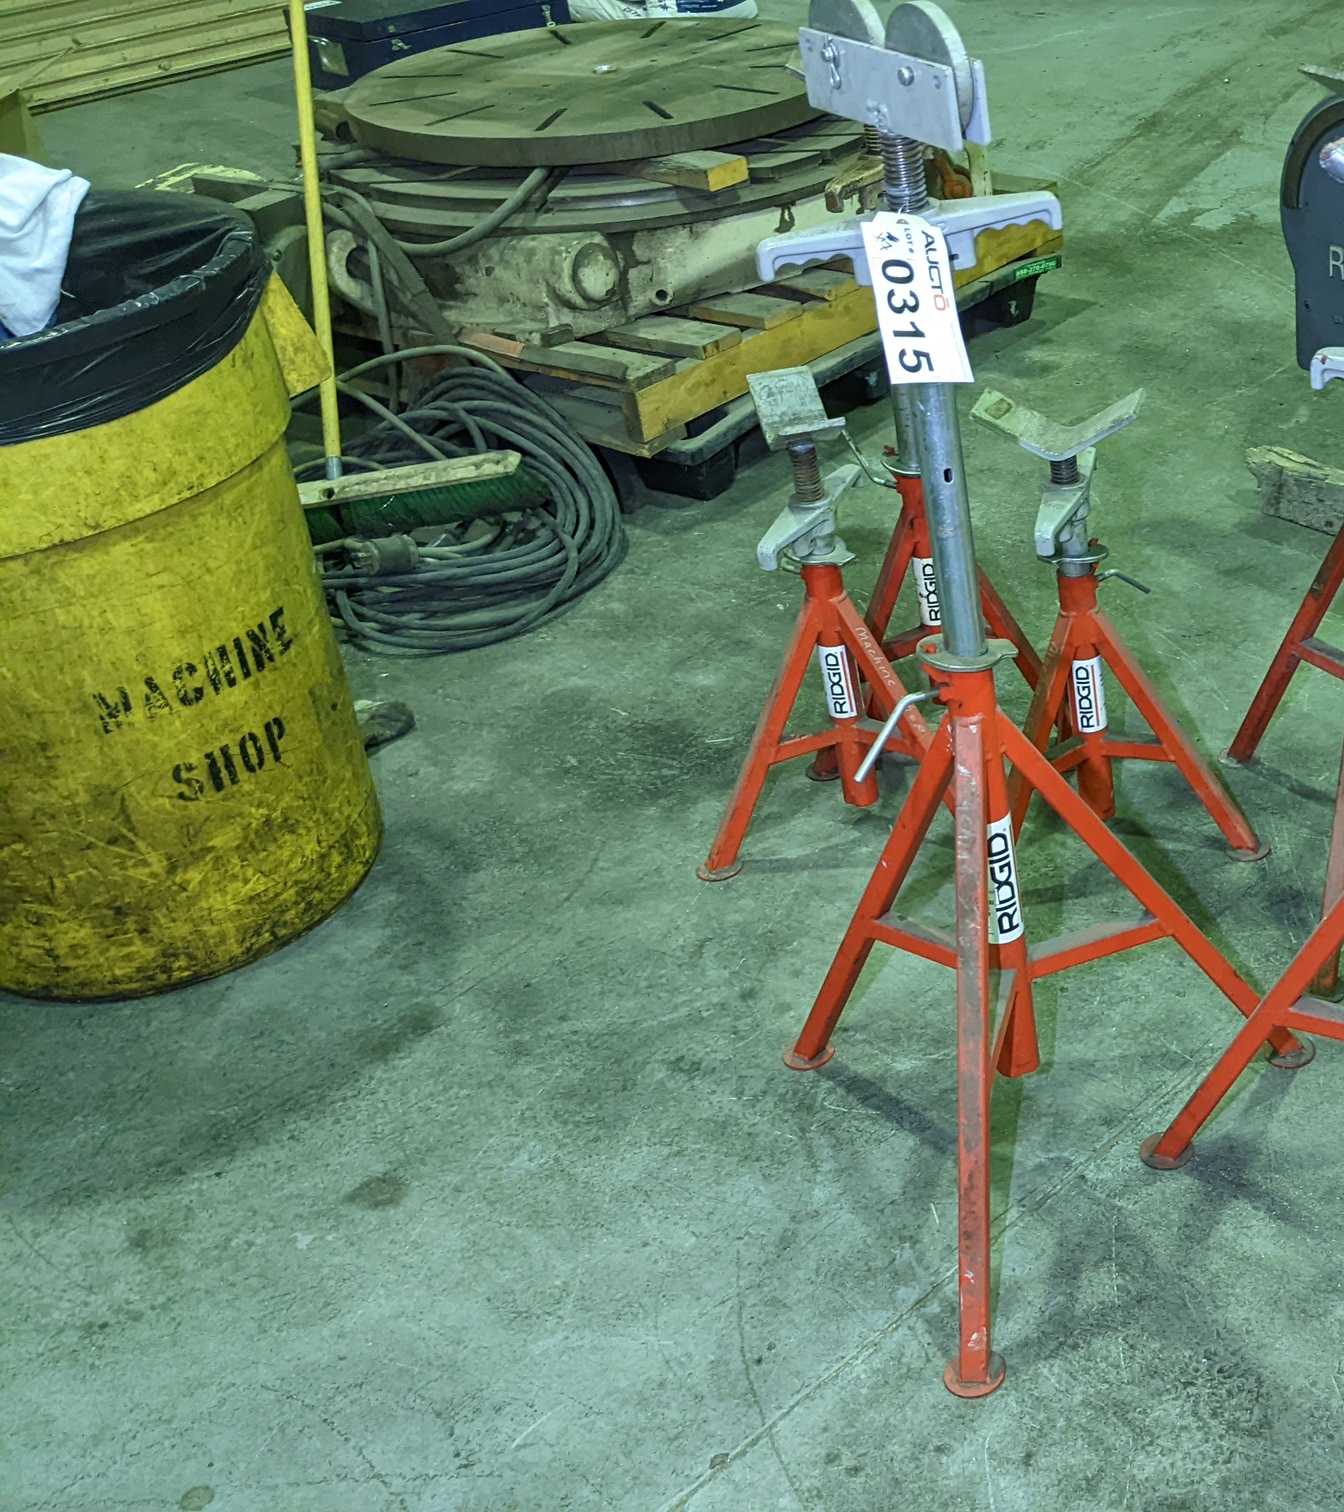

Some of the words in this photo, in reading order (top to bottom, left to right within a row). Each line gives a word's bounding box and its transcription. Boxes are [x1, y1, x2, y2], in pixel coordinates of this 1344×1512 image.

[904, 228, 913, 247] LOT
[882, 259, 934, 373] 0315
[923, 563, 941, 621] RIDGID
[93, 607, 293, 735] MACHINE
[825, 653, 848, 714] RIDGID
[1075, 666, 1095, 728] RIDGID
[172, 717, 286, 802] SHOP
[987, 832, 1020, 934] RIDGID
